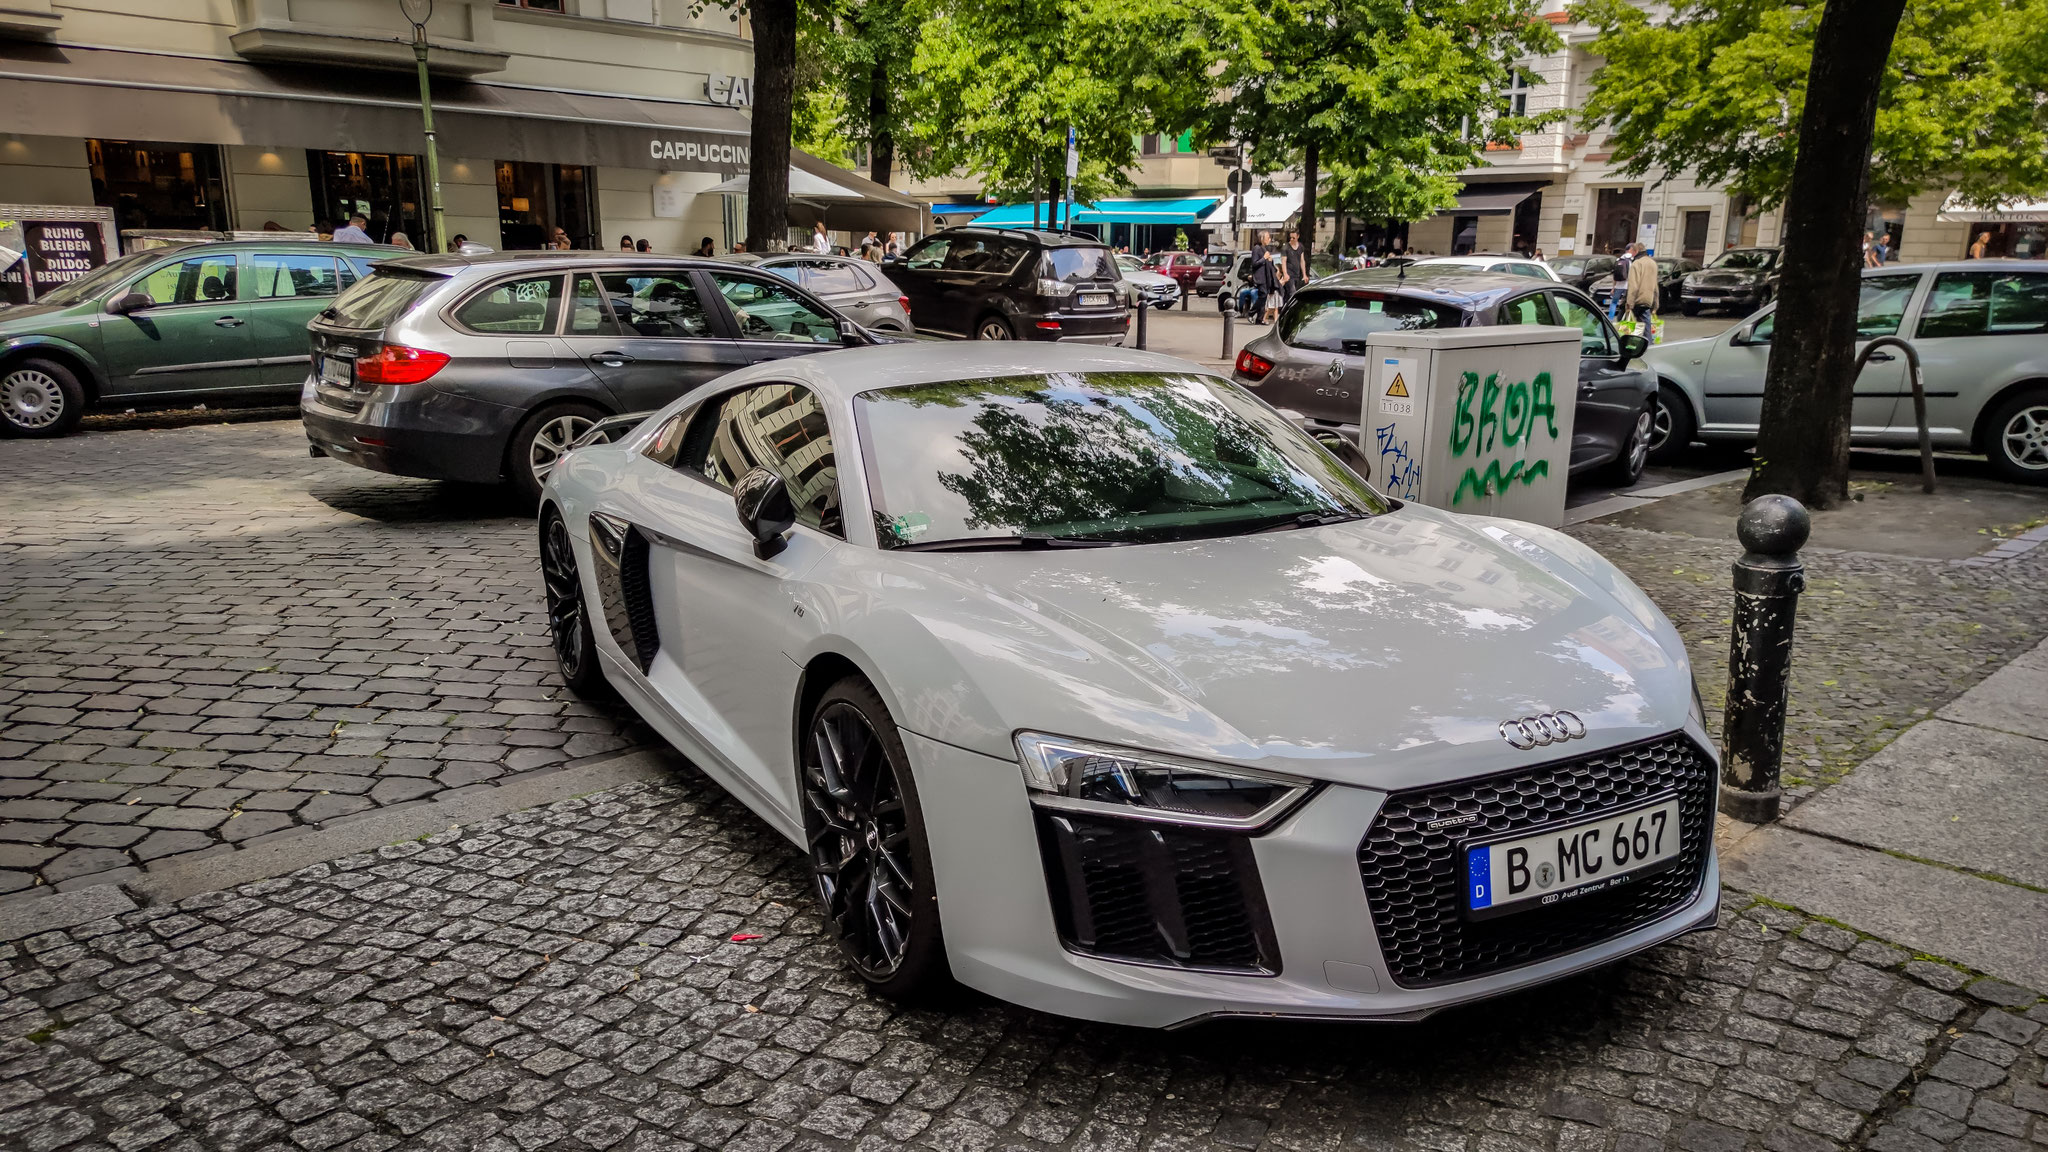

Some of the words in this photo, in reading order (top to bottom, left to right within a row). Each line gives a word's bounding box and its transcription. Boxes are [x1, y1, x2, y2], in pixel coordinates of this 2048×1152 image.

[709, 72, 753, 106] CA
[650, 140, 751, 165] CAPPUCCIN
[43, 227, 84, 239] RUHIG
[40, 240, 91, 252] BLEIBEN
[47, 259, 91, 270] DILDOS
[36, 271, 90, 283] BENUTZ
[1383, 402, 1411, 413] 11038
[1430, 816, 1476, 829] quattro
[1507, 846, 1531, 895] B
[1557, 828, 1603, 883] MC
[1612, 809, 1668, 867] 667
[1475, 884, 1485, 898] D
[1562, 890, 1579, 899] Audi
